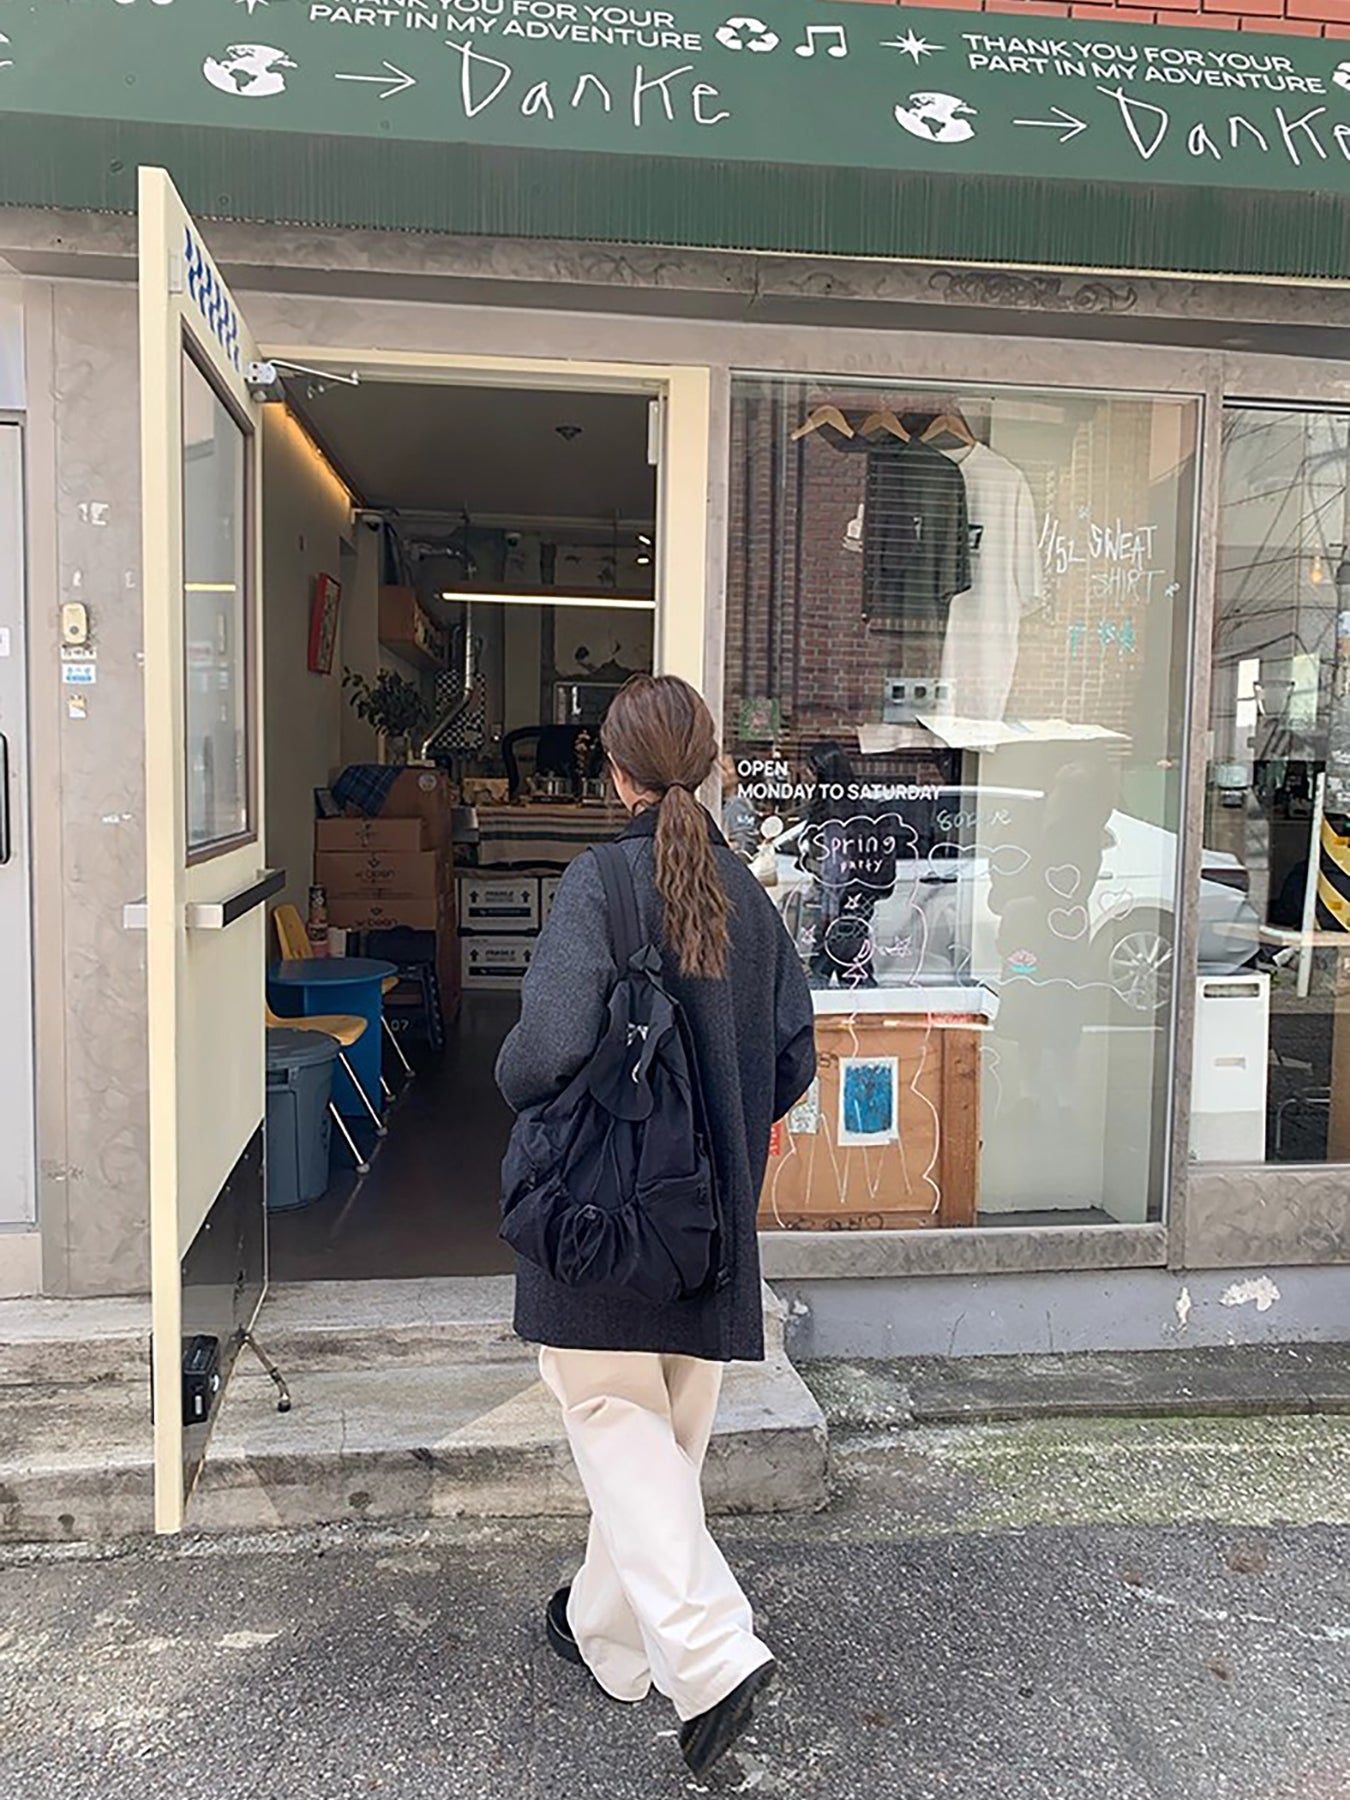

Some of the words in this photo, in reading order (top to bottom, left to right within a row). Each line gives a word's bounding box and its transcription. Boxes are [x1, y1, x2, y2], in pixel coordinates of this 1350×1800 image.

[310, 4, 400, 27] PART
[406, 12, 438, 30] IN
[447, 15, 497, 34] MY
[502, 20, 702, 51] ADVENTURE
[440, 0, 504, 14] YOU
[513, 0, 578, 20] FOR
[584, 6, 675, 28] YOUR
[962, 33, 1072, 58] THANK
[1072, 41, 1138, 62] YOU
[1144, 47, 1206, 66] FOR
[1208, 51, 1294, 73] YOUR
[969, 53, 1049, 75] PART
[1054, 60, 1086, 77] IN
[1091, 62, 1137, 80] MY
[1145, 65, 1327, 94] ADVENTURE
[1088, 517, 1158, 571] SWEAT
[1090, 567, 1165, 604] SHIRT
[737, 759, 789, 777] OPEN
[737, 783, 816, 800] MONDAY
[818, 784, 845, 800] TO
[847, 783, 940, 801] SATURDAY
[812, 831, 896, 863] Spring
[390, 1018, 410, 1032] 07
